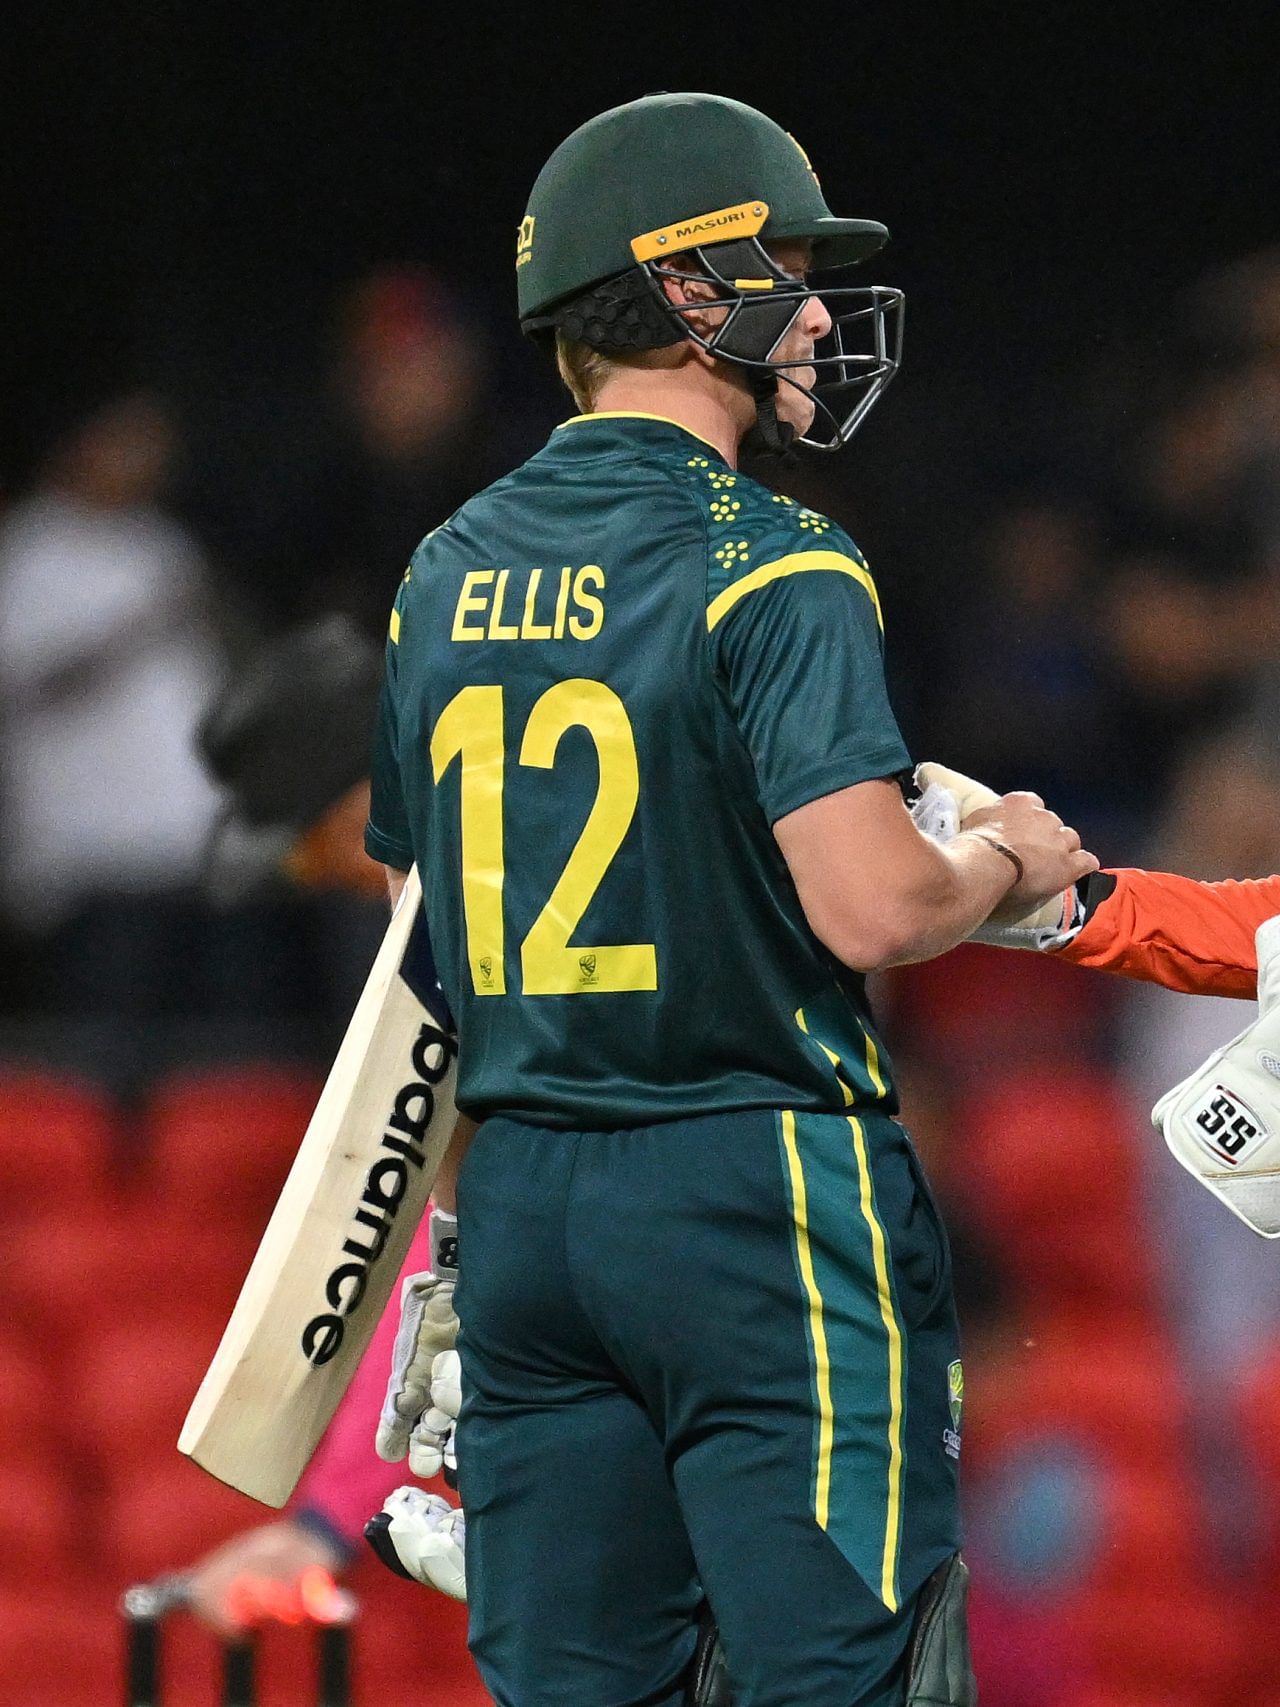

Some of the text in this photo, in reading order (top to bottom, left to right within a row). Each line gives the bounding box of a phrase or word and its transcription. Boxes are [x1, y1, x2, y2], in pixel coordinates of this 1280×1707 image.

[676, 211, 745, 238] MASURI
[451, 565, 606, 642] ELLIS
[430, 678, 658, 996] 12
[1196, 1094, 1257, 1156] SS
[301, 1023, 457, 1367] balance
